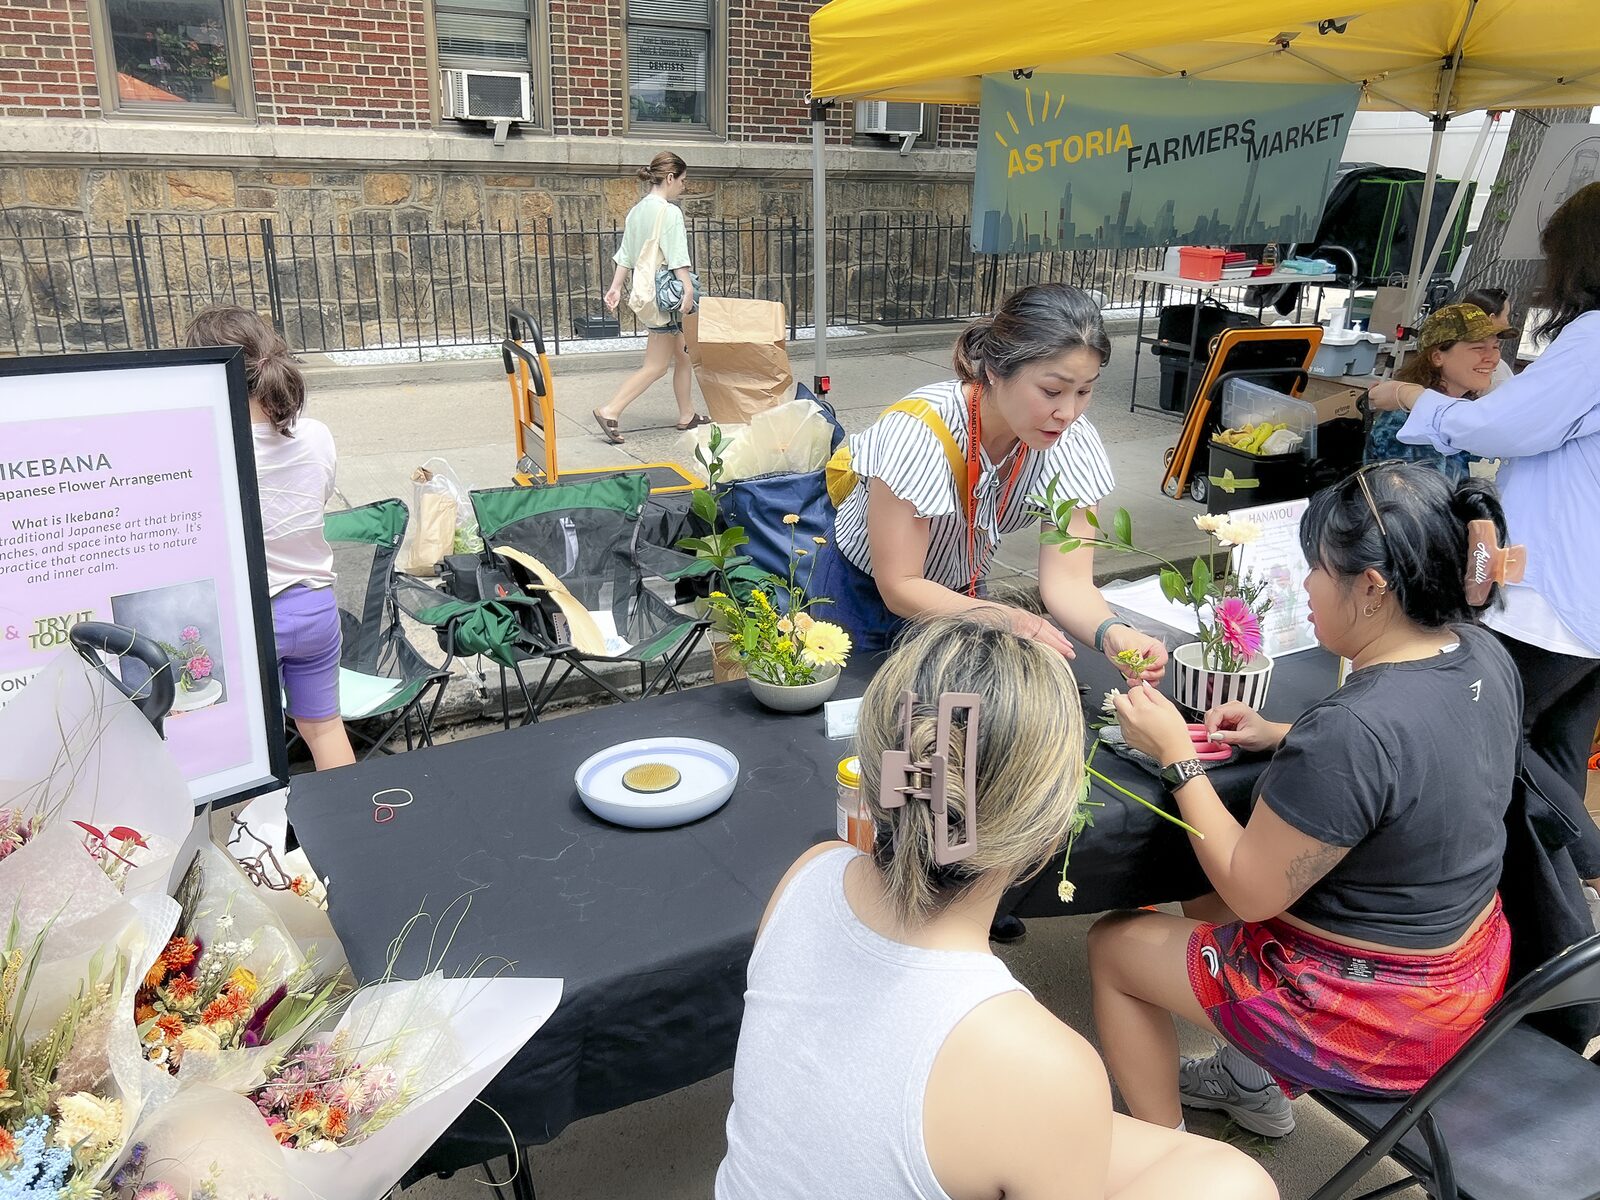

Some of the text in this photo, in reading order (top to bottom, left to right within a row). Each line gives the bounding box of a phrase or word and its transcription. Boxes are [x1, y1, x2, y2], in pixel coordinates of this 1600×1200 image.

[1007, 112, 1345, 178] ASTORIA FARMERS MARKET
[0, 453, 112, 481] IKEBANA
[59, 480, 106, 493] Flower
[109, 469, 193, 488] Arrangement
[12, 507, 120, 530] What is Ikebana?
[1248, 507, 1294, 524] HANAYOU
[0, 510, 202, 547] traditional Japanese art that brings
[41, 541, 64, 555] and
[68, 538, 101, 552] space
[104, 534, 127, 546] into
[130, 527, 180, 542] harmony.
[186, 522, 202, 533] It's
[51, 555, 77, 567] that
[80, 547, 131, 562] connects
[133, 543, 146, 554] us
[149, 541, 160, 552] to
[163, 537, 198, 550] nature
[27, 562, 119, 584] and inner calm.
[35, 611, 92, 634] TRY IT
[28, 629, 70, 649] TOD
